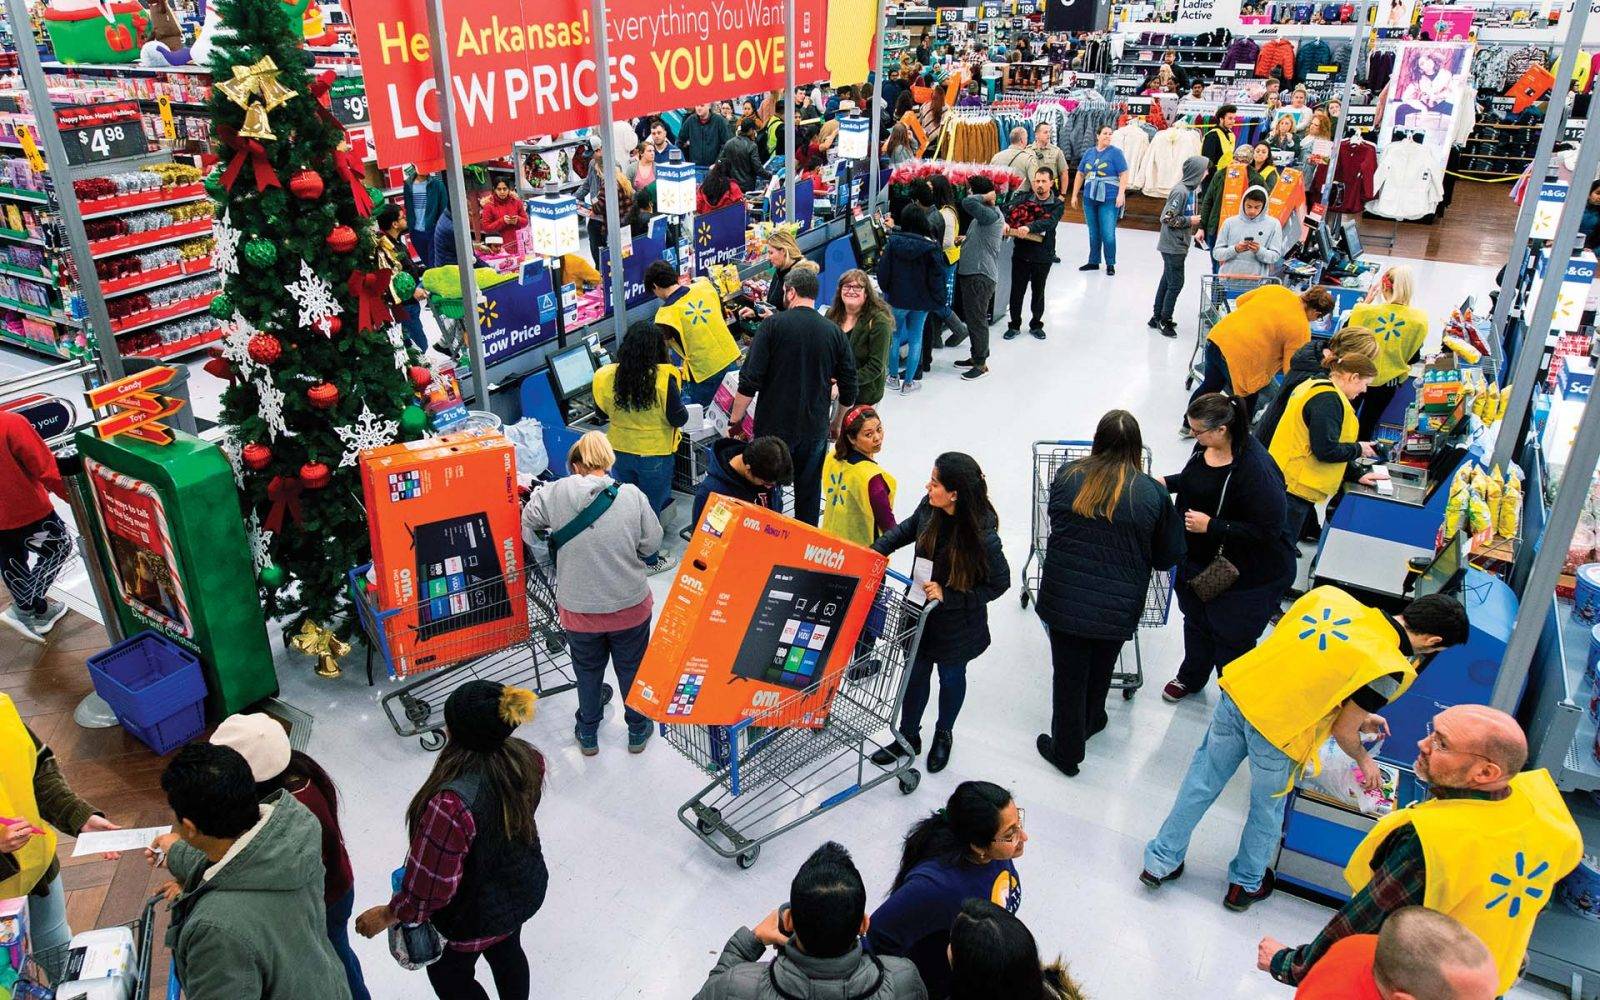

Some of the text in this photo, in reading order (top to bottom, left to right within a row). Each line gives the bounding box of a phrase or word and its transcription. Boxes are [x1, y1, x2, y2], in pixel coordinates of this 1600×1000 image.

[605, 0, 785, 47] Everything You Want
[1181, 10, 1212, 20] Active
[378, 9, 591, 65] He Arkansas!
[650, 36, 786, 93] YOU LOVE
[387, 54, 639, 140] LOW PRICES
[1540, 188, 1566, 198] n&Go
[531, 205, 554, 215] Scan&Go
[482, 324, 541, 358] Low Price
[118, 380, 142, 394] Candy
[37, 415, 59, 430] your
[129, 412, 147, 423] Toys
[743, 517, 760, 532] onn.
[503, 537, 520, 585] watch
[804, 543, 845, 570] watch
[681, 574, 704, 592] onn.
[131, 607, 149, 624] Days
[165, 626, 202, 654] Christmas
